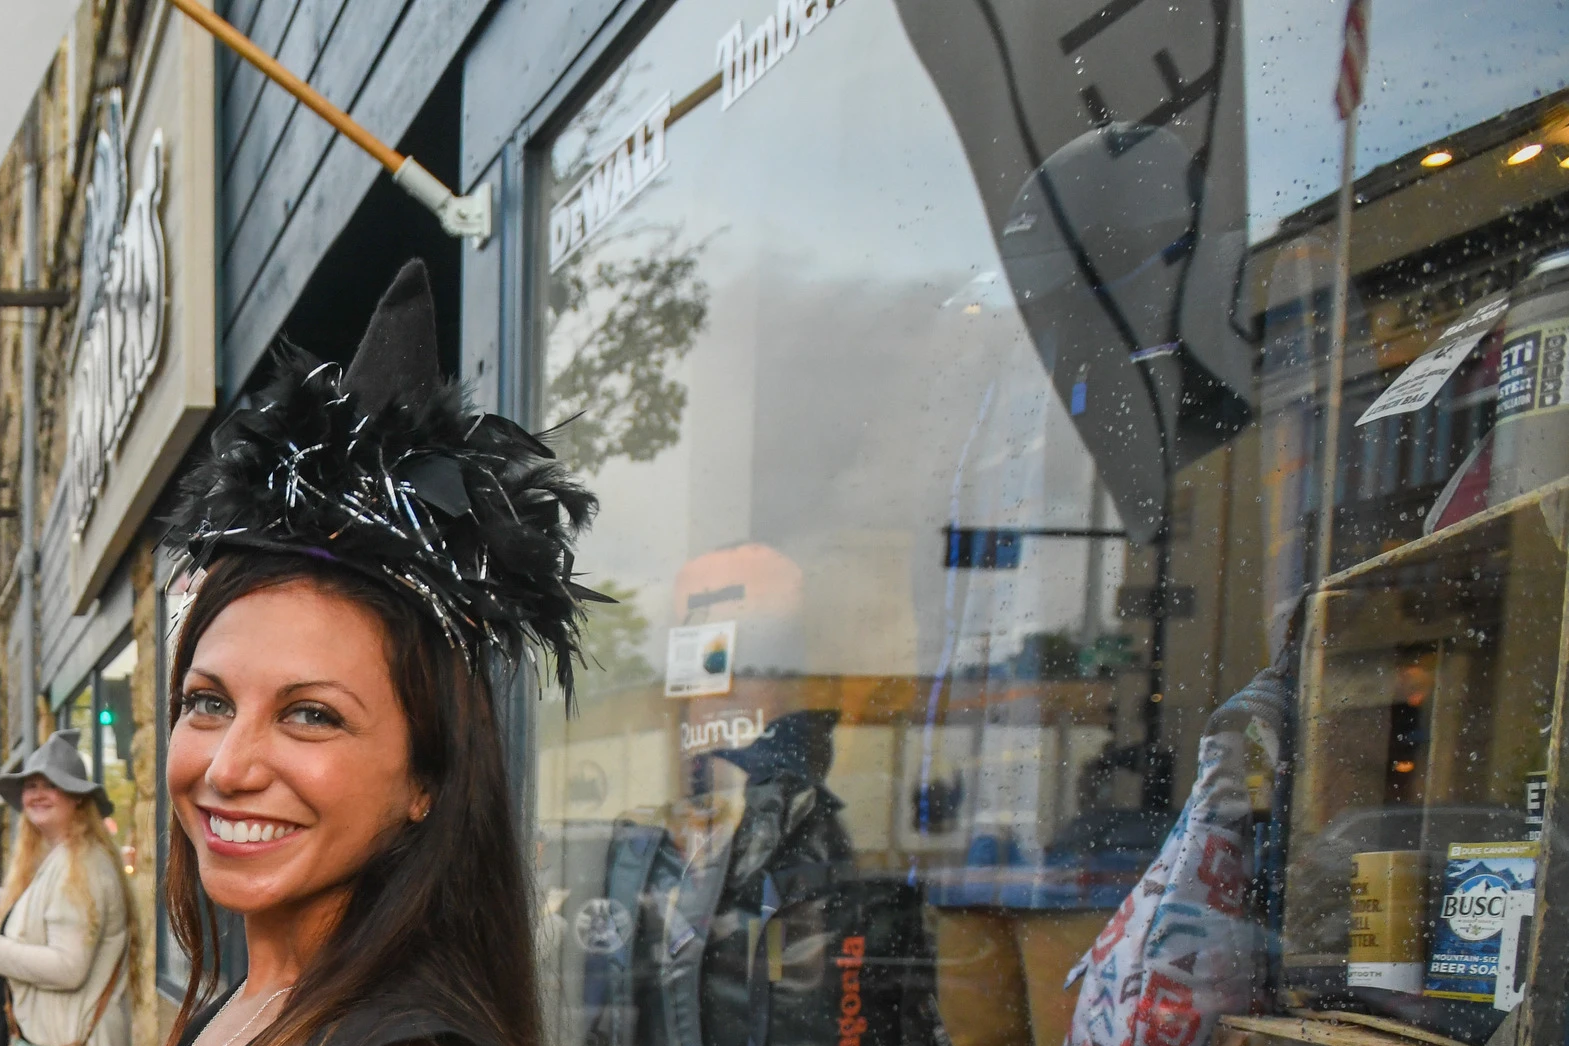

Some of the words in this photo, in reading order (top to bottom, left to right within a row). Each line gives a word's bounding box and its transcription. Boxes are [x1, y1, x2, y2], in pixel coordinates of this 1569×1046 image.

[550, 98, 671, 266] DEWALT
[1501, 340, 1533, 370] ETI
[1431, 962, 1465, 974] BEER
[1469, 963, 1499, 975] SOA
[1432, 954, 1498, 963] MOUNTAIN-SIZ
